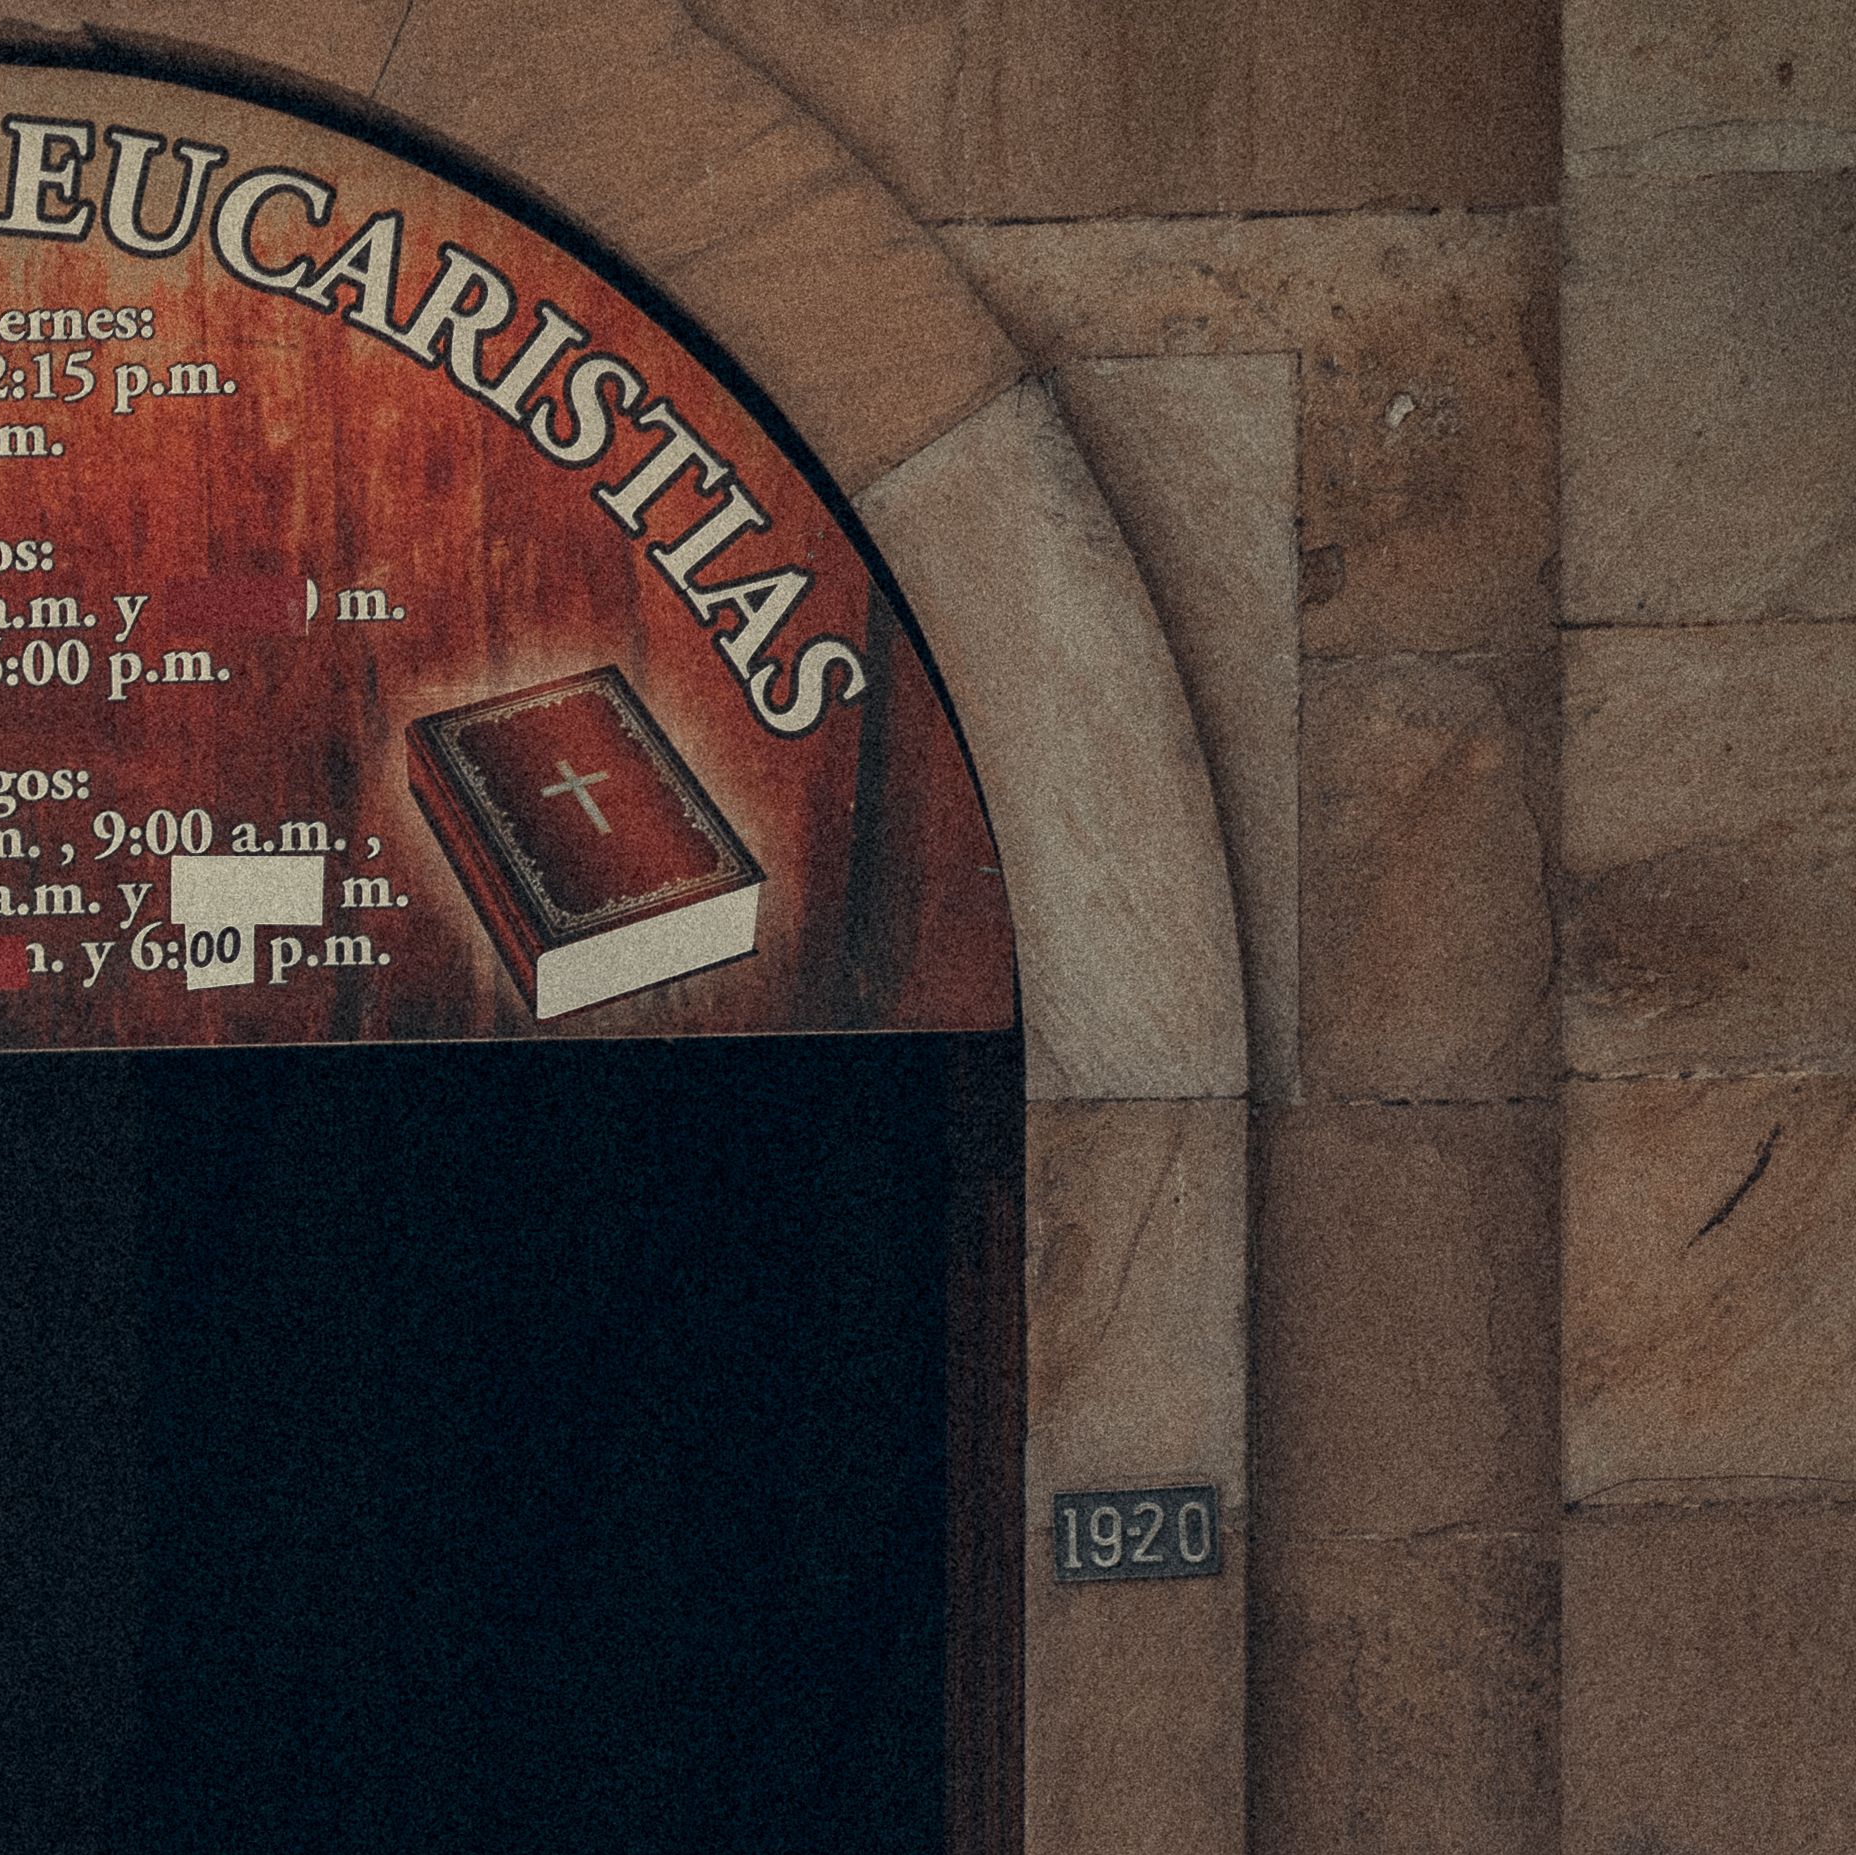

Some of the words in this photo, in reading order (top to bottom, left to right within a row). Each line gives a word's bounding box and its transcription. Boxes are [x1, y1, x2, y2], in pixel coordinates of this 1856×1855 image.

[115, 366, 236, 412] p.m.
[116, 596, 146, 641] y
[109, 652, 229, 700] p.m.
[93, 809, 213, 860] 9:00
[231, 820, 346, 853] a.m.
[118, 884, 153, 930] y
[83, 942, 113, 987] y
[130, 922, 242, 971] 6:00
[271, 936, 390, 983] p.m.
